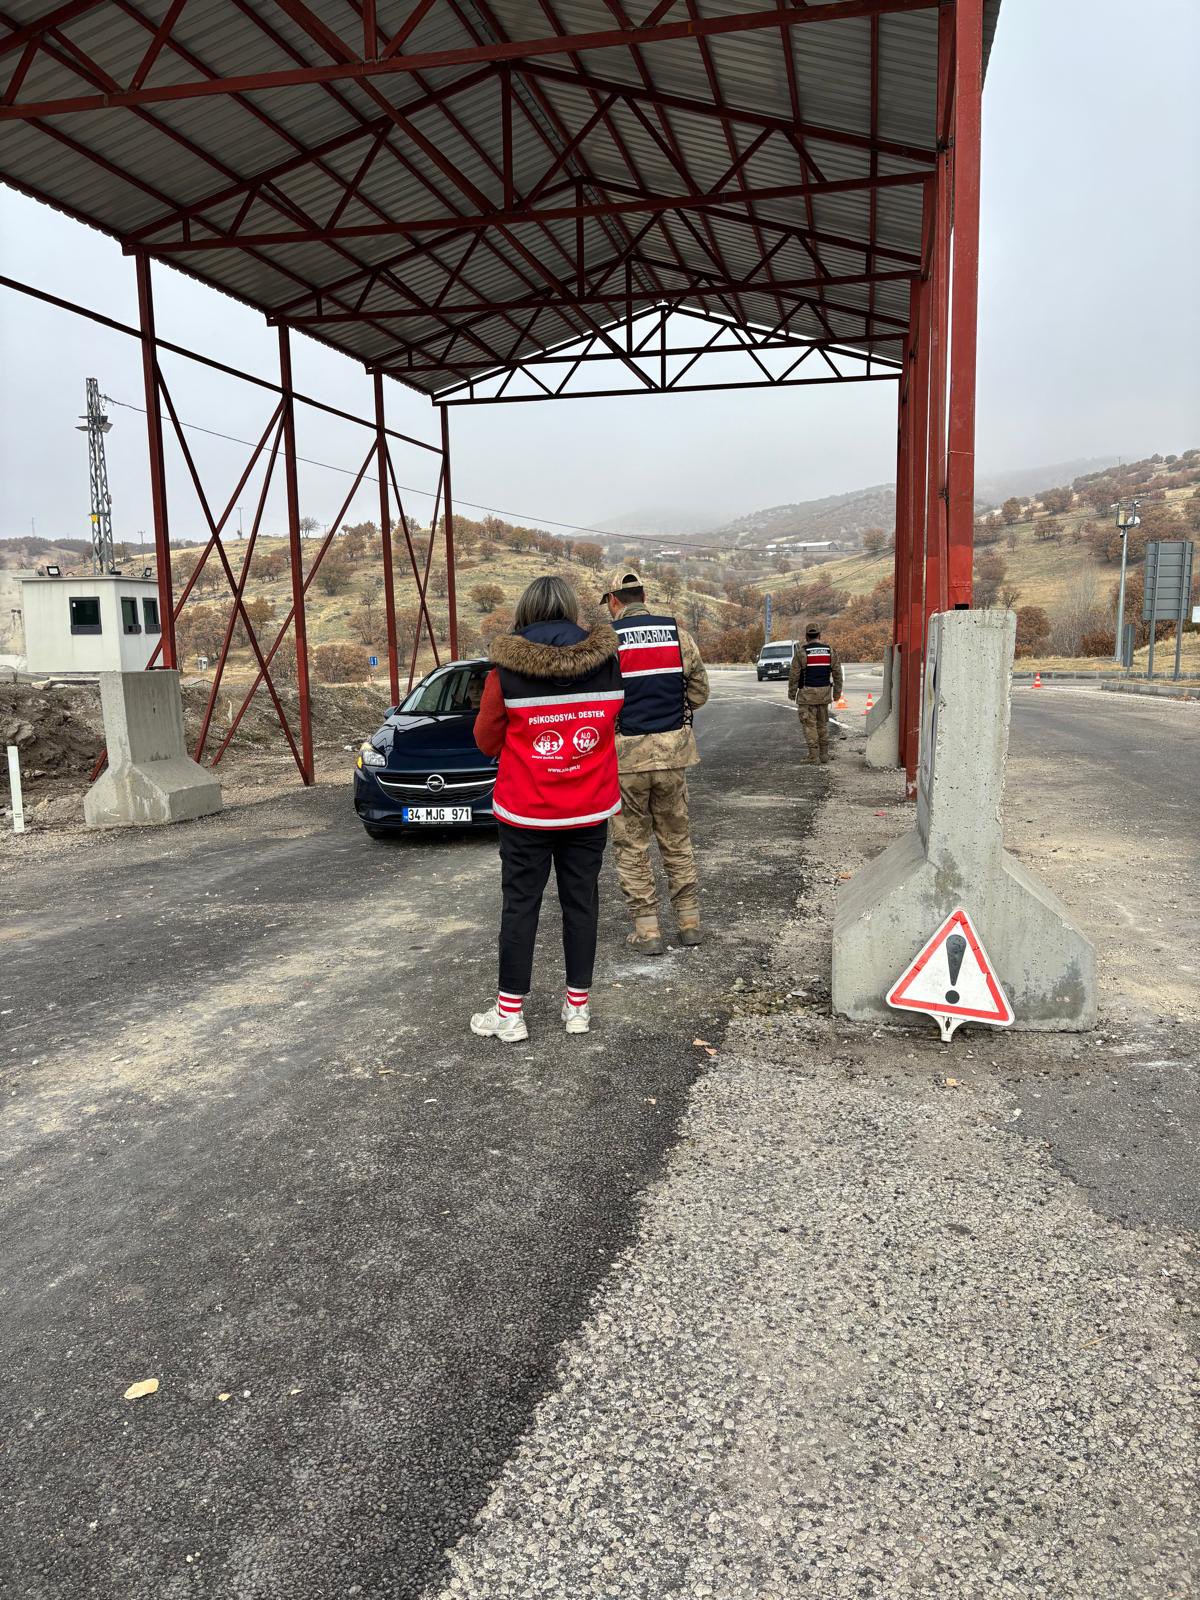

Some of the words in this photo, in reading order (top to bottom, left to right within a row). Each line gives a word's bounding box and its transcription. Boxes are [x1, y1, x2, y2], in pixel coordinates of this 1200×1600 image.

[623, 629, 673, 645] JANDARMA
[528, 713, 577, 725] PSİKOSOSYAL
[578, 710, 605, 719] DESTEK
[538, 741, 559, 751] 183
[408, 809, 421, 820] 34
[425, 809, 445, 820] MJG
[451, 808, 469, 820] 971
